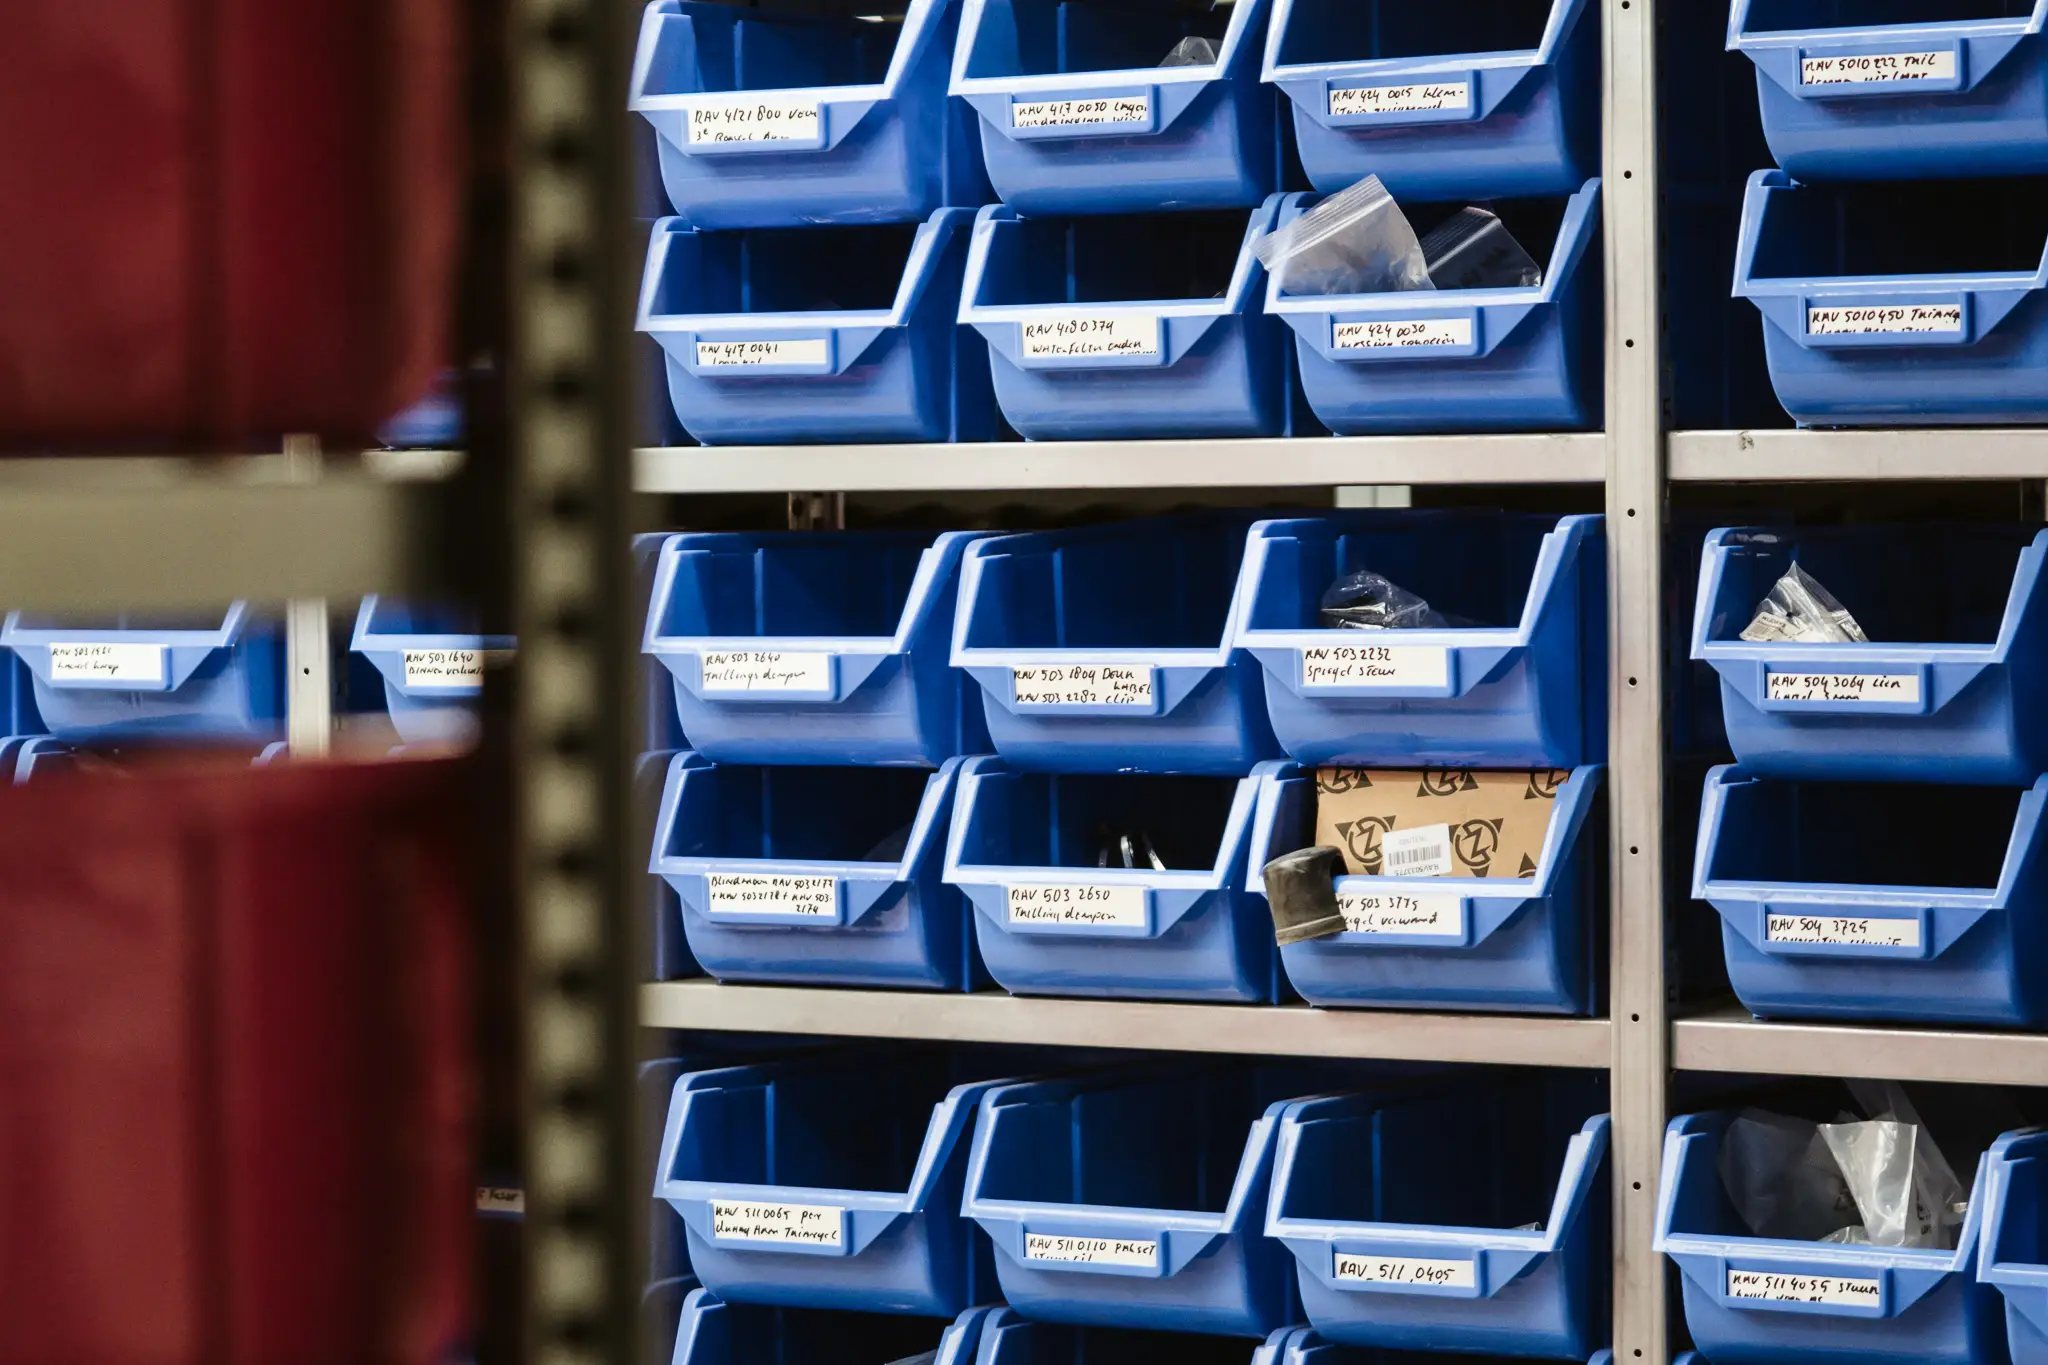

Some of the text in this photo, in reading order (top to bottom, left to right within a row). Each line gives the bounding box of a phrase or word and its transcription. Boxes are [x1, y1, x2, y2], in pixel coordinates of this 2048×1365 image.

[1333, 90, 1356, 102] RAV
[1360, 90, 1380, 103] 424
[694, 110, 720, 124] RAV
[1026, 324, 1053, 338] RAV
[1368, 324, 1392, 338] 424
[1396, 324, 1426, 338] 0030
[700, 342, 778, 358] RAV 417 0041
[406, 653, 426, 663] RAV
[706, 654, 729, 666] RAV
[732, 652, 748, 662] 503
[1305, 648, 1330, 660] RAV
[1014, 670, 1036, 680] RAV
[1041, 669, 1064, 682] 503
[1771, 676, 1798, 687] RAV
[1042, 692, 1061, 704] 503
[1066, 689, 1097, 704] 2282
[1011, 886, 1110, 902] RAV 503 2650
[1360, 898, 1380, 911] 503
[1389, 896, 1419, 911] 3775
[1770, 919, 1795, 932] RAV
[1800, 918, 1822, 936] 504
[1029, 1237, 1052, 1249] RAV
[1379, 1264, 1404, 1280] 511
